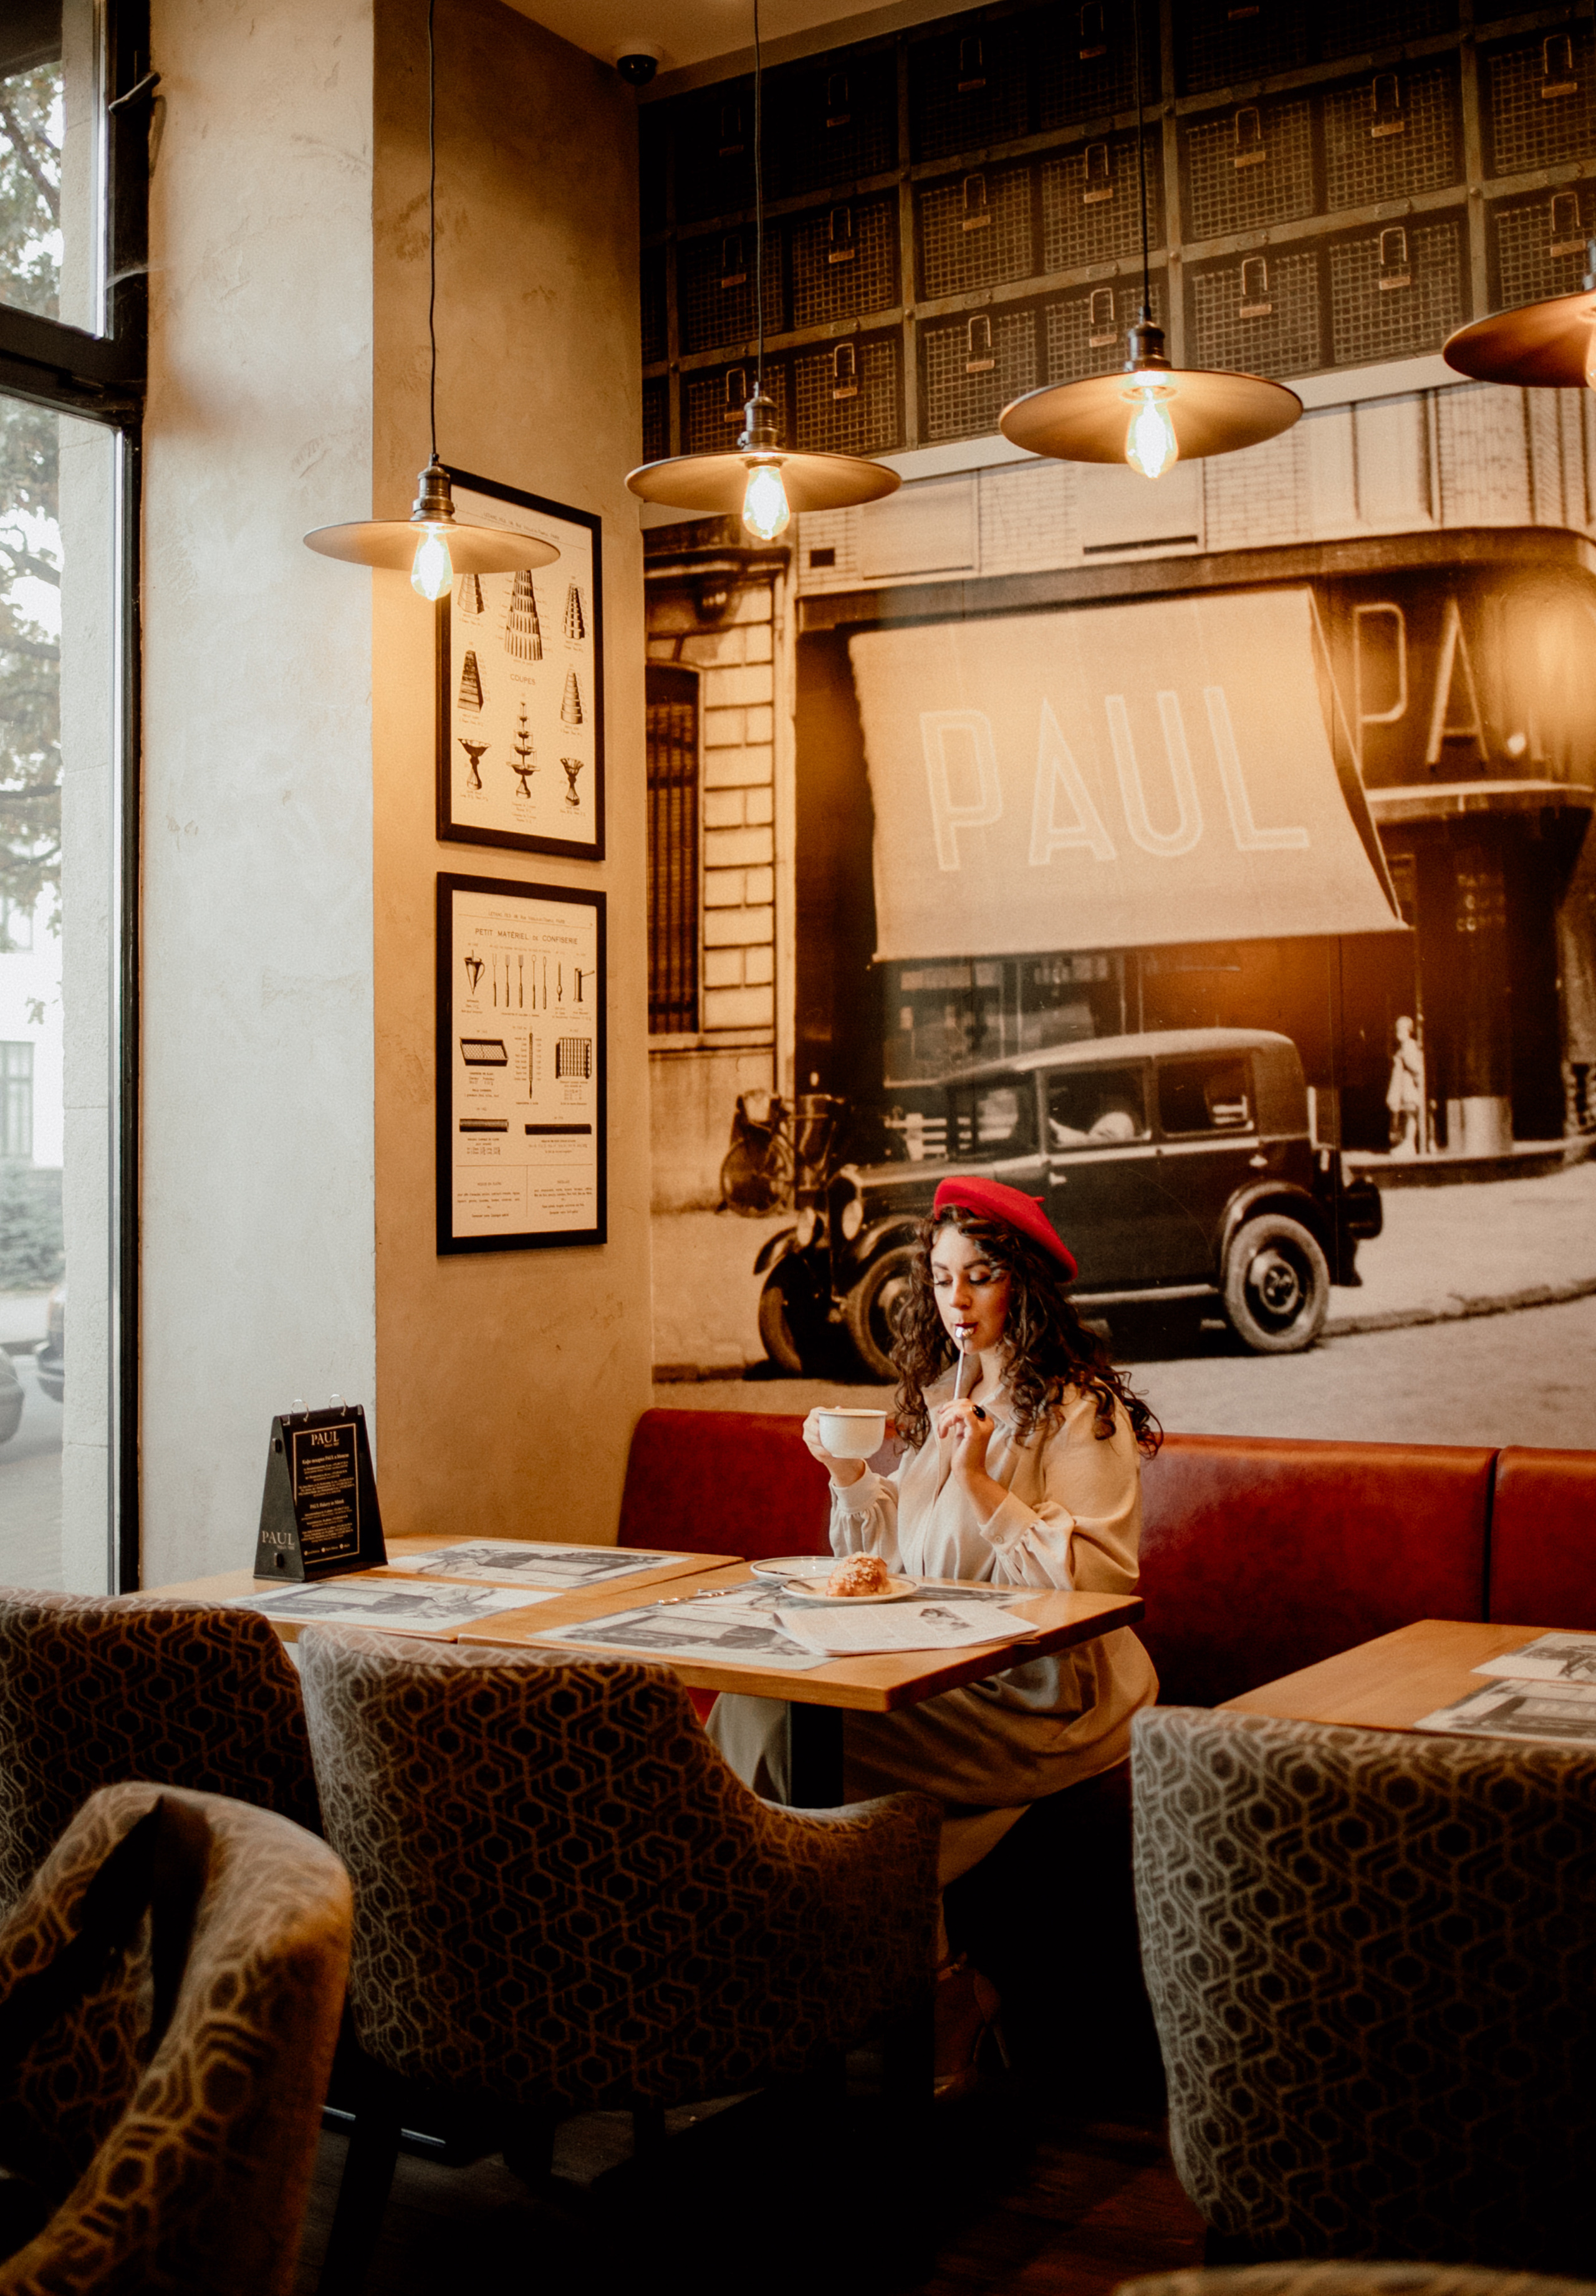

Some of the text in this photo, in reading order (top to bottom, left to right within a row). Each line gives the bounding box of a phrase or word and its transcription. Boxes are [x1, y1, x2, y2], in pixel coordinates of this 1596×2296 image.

[510, 673, 536, 686] COUPES
[919, 685, 1311, 872] PAUL
[475, 928, 493, 936] PETIT
[498, 929, 529, 940] MATÉRIEL
[542, 935, 578, 945] CONFISERIE
[311, 1431, 340, 1446] PAUL
[262, 1530, 296, 1545] PAUL
